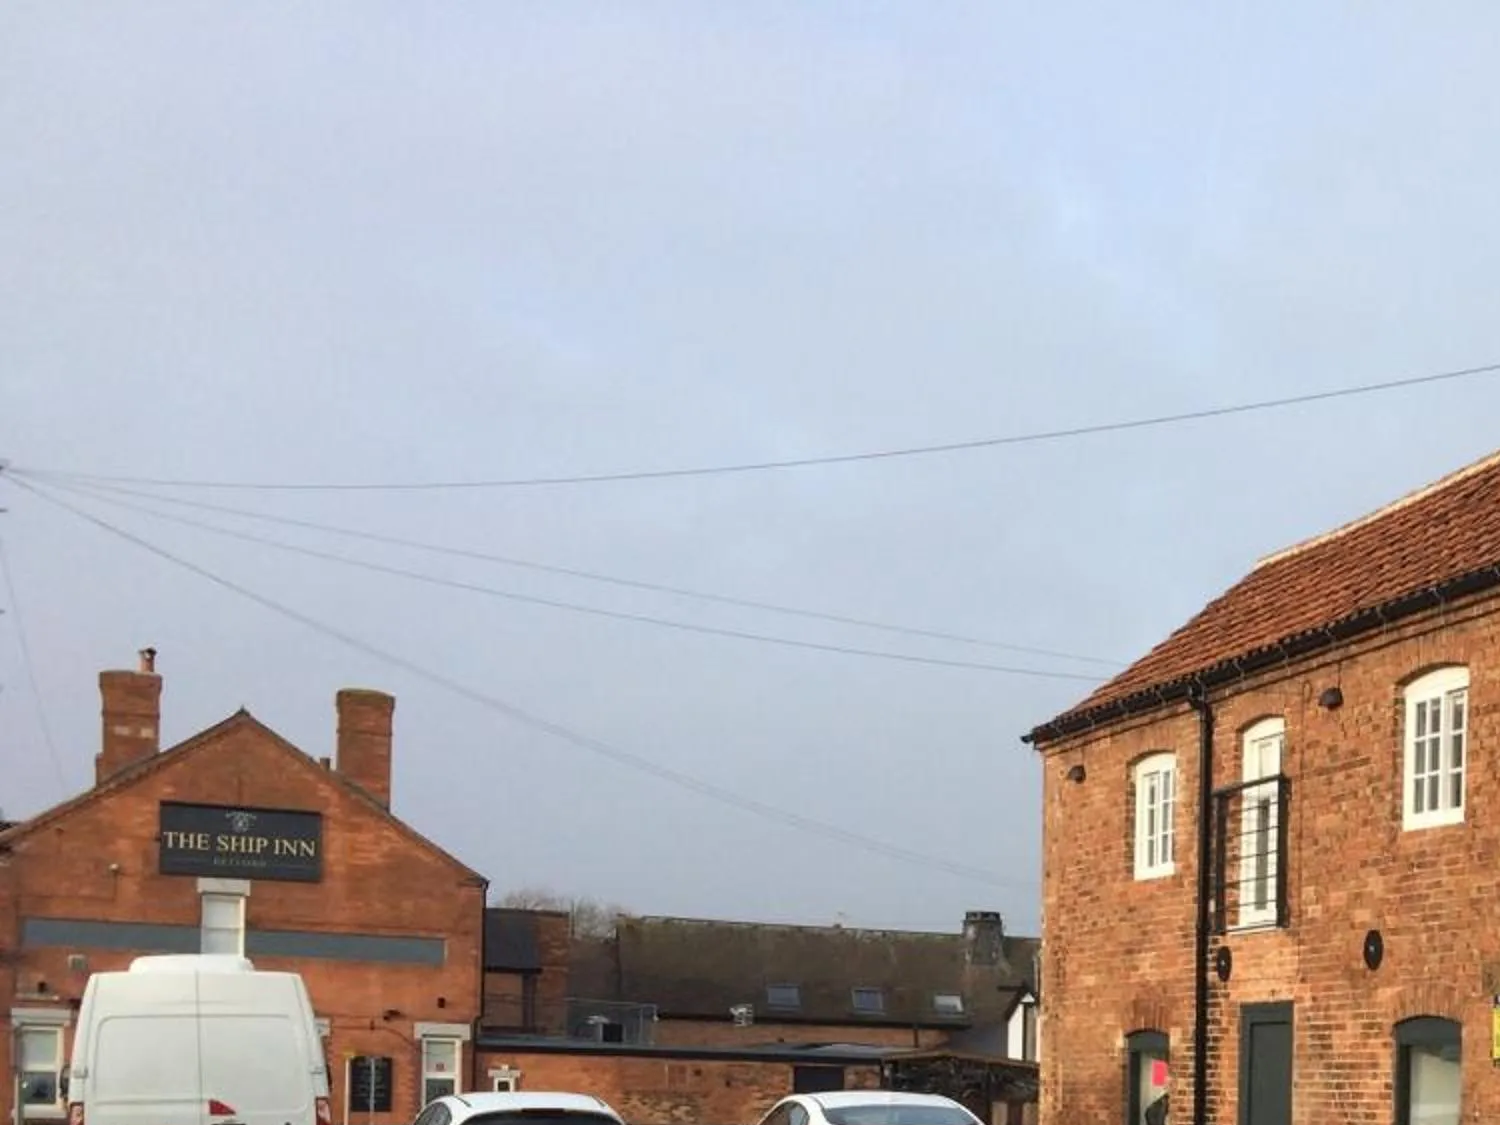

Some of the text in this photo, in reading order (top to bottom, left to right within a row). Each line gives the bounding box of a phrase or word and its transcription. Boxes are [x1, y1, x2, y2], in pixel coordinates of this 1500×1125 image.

[163, 831, 316, 857] THE SHIP INN
